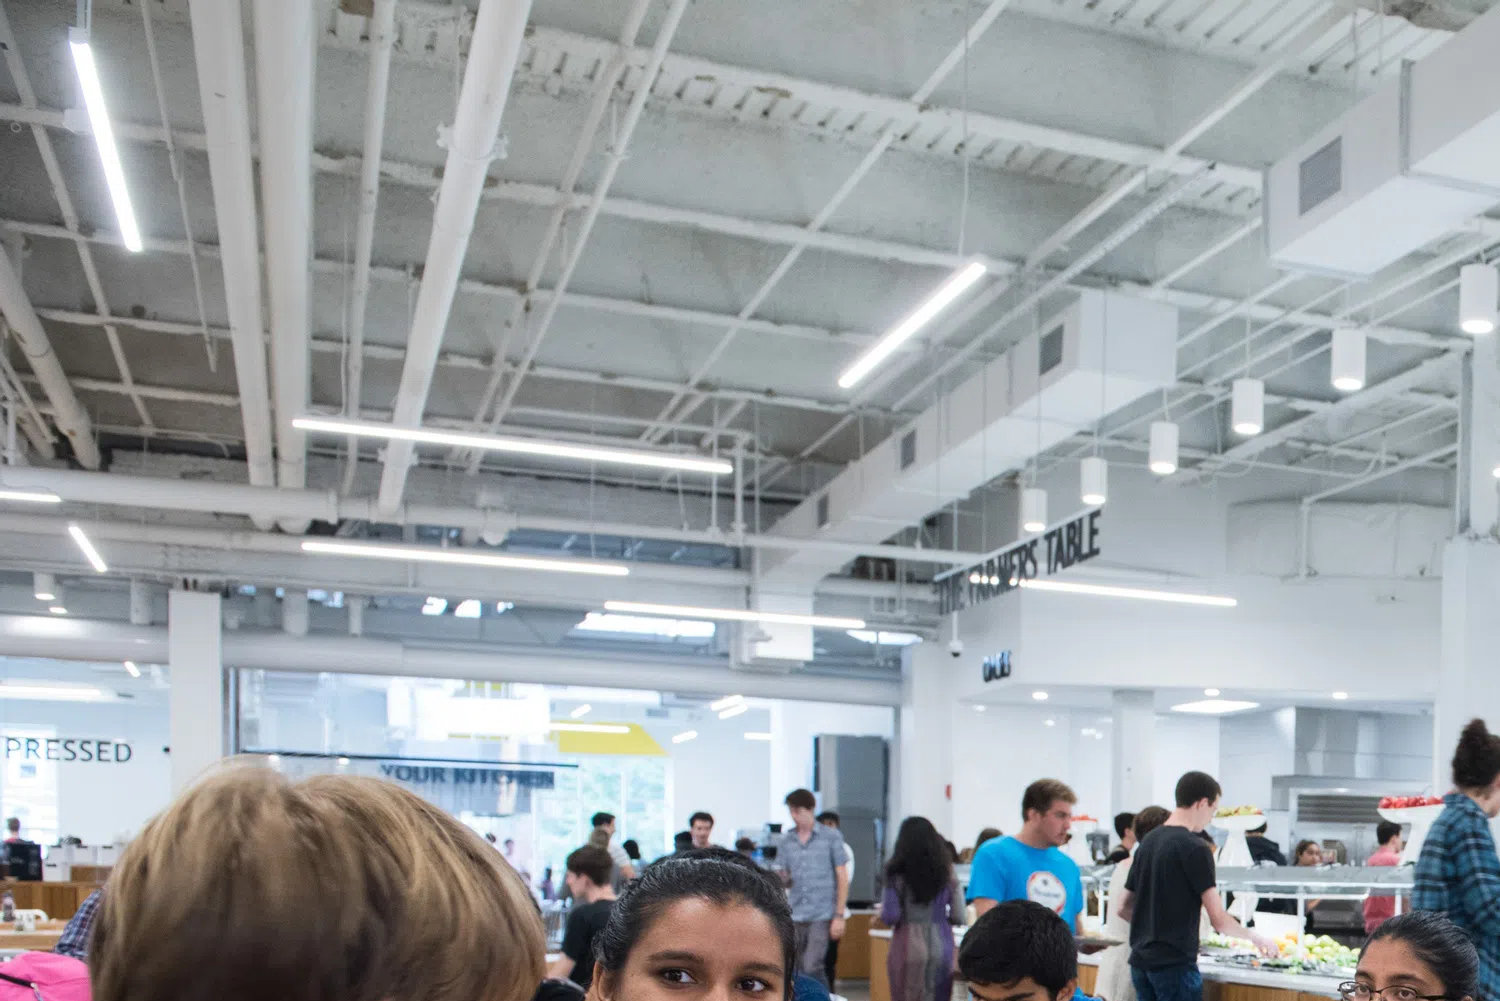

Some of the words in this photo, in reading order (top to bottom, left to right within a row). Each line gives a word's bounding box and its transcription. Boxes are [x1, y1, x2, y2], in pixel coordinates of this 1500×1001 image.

[1045, 509, 1102, 576] TABLE
[6, 737, 132, 763] PRESSED
[381, 765, 445, 784] YOUR
